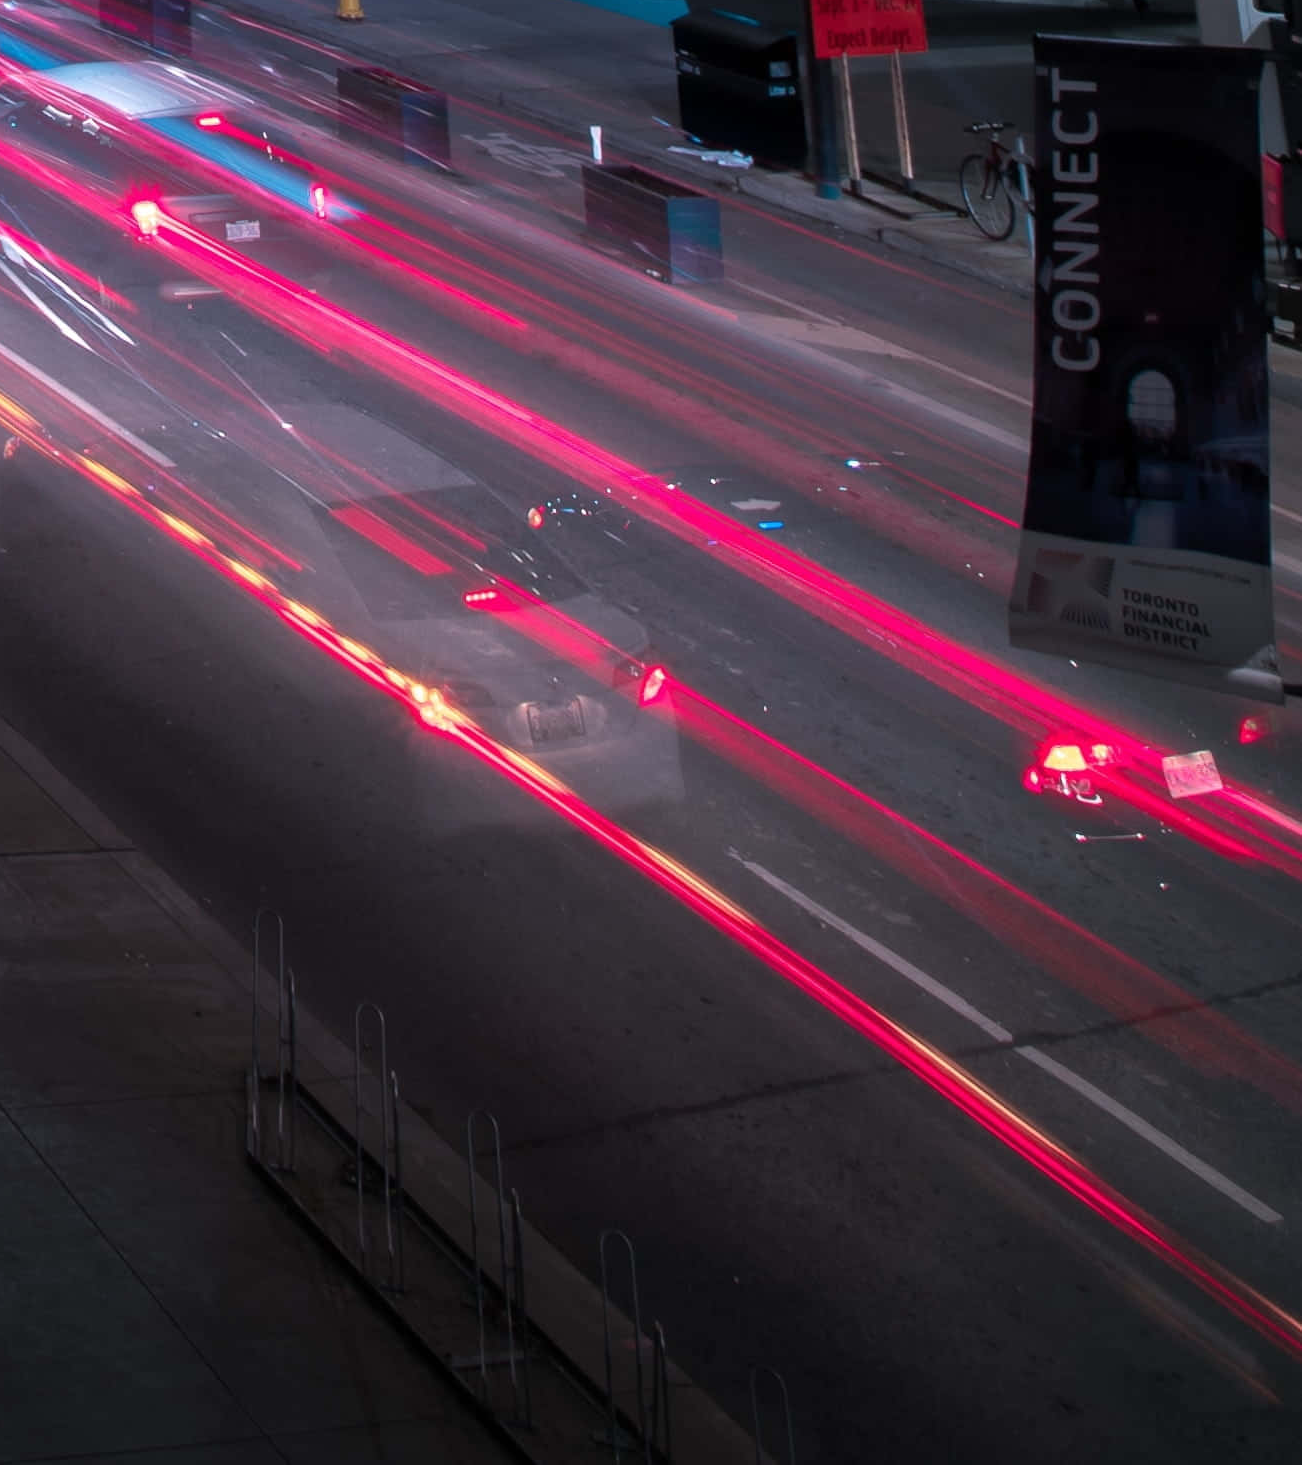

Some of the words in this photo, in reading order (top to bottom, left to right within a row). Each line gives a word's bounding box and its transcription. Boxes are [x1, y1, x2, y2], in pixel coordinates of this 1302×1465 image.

[1052, 66, 1100, 374] CONNECT
[1122, 588, 1200, 618] TORONTO
[1121, 604, 1212, 638] FINANCIAL
[1123, 622, 1199, 651] DISTRICT
